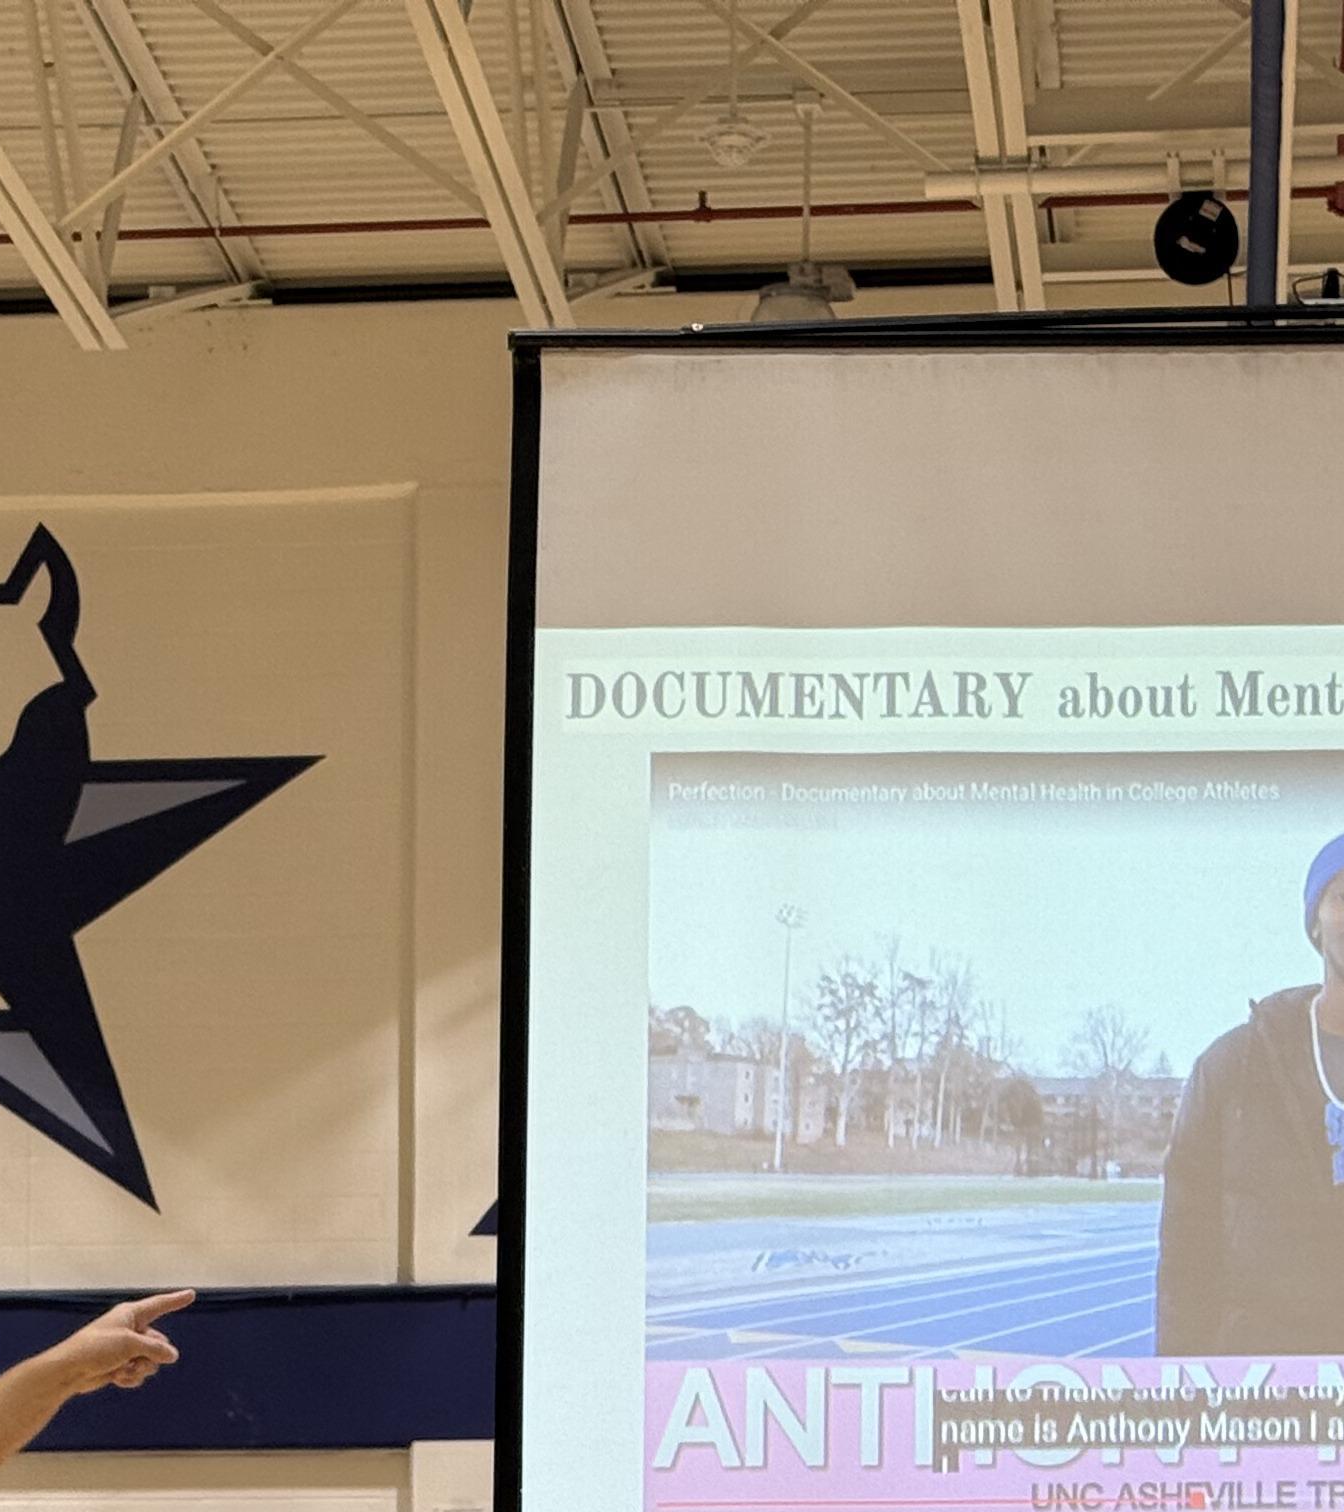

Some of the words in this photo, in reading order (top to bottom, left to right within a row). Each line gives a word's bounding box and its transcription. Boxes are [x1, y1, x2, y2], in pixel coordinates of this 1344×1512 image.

[565, 669, 1032, 721] DOCUMENTARY
[1058, 670, 1197, 720] about
[669, 782, 765, 801] Perfection
[782, 782, 906, 804] Documentary
[913, 781, 964, 801] about
[971, 782, 1035, 801] Mental
[1041, 782, 1101, 801] Health
[1105, 781, 1123, 800] in
[1129, 782, 1198, 804] College
[1204, 781, 1280, 800] Athletes
[940, 1418, 1024, 1444] name
[1066, 1411, 1191, 1450] Anthony
[1200, 1410, 1300, 1443] Mason
[1309, 1409, 1318, 1441] I
[1030, 1483, 1104, 1511] UNC
